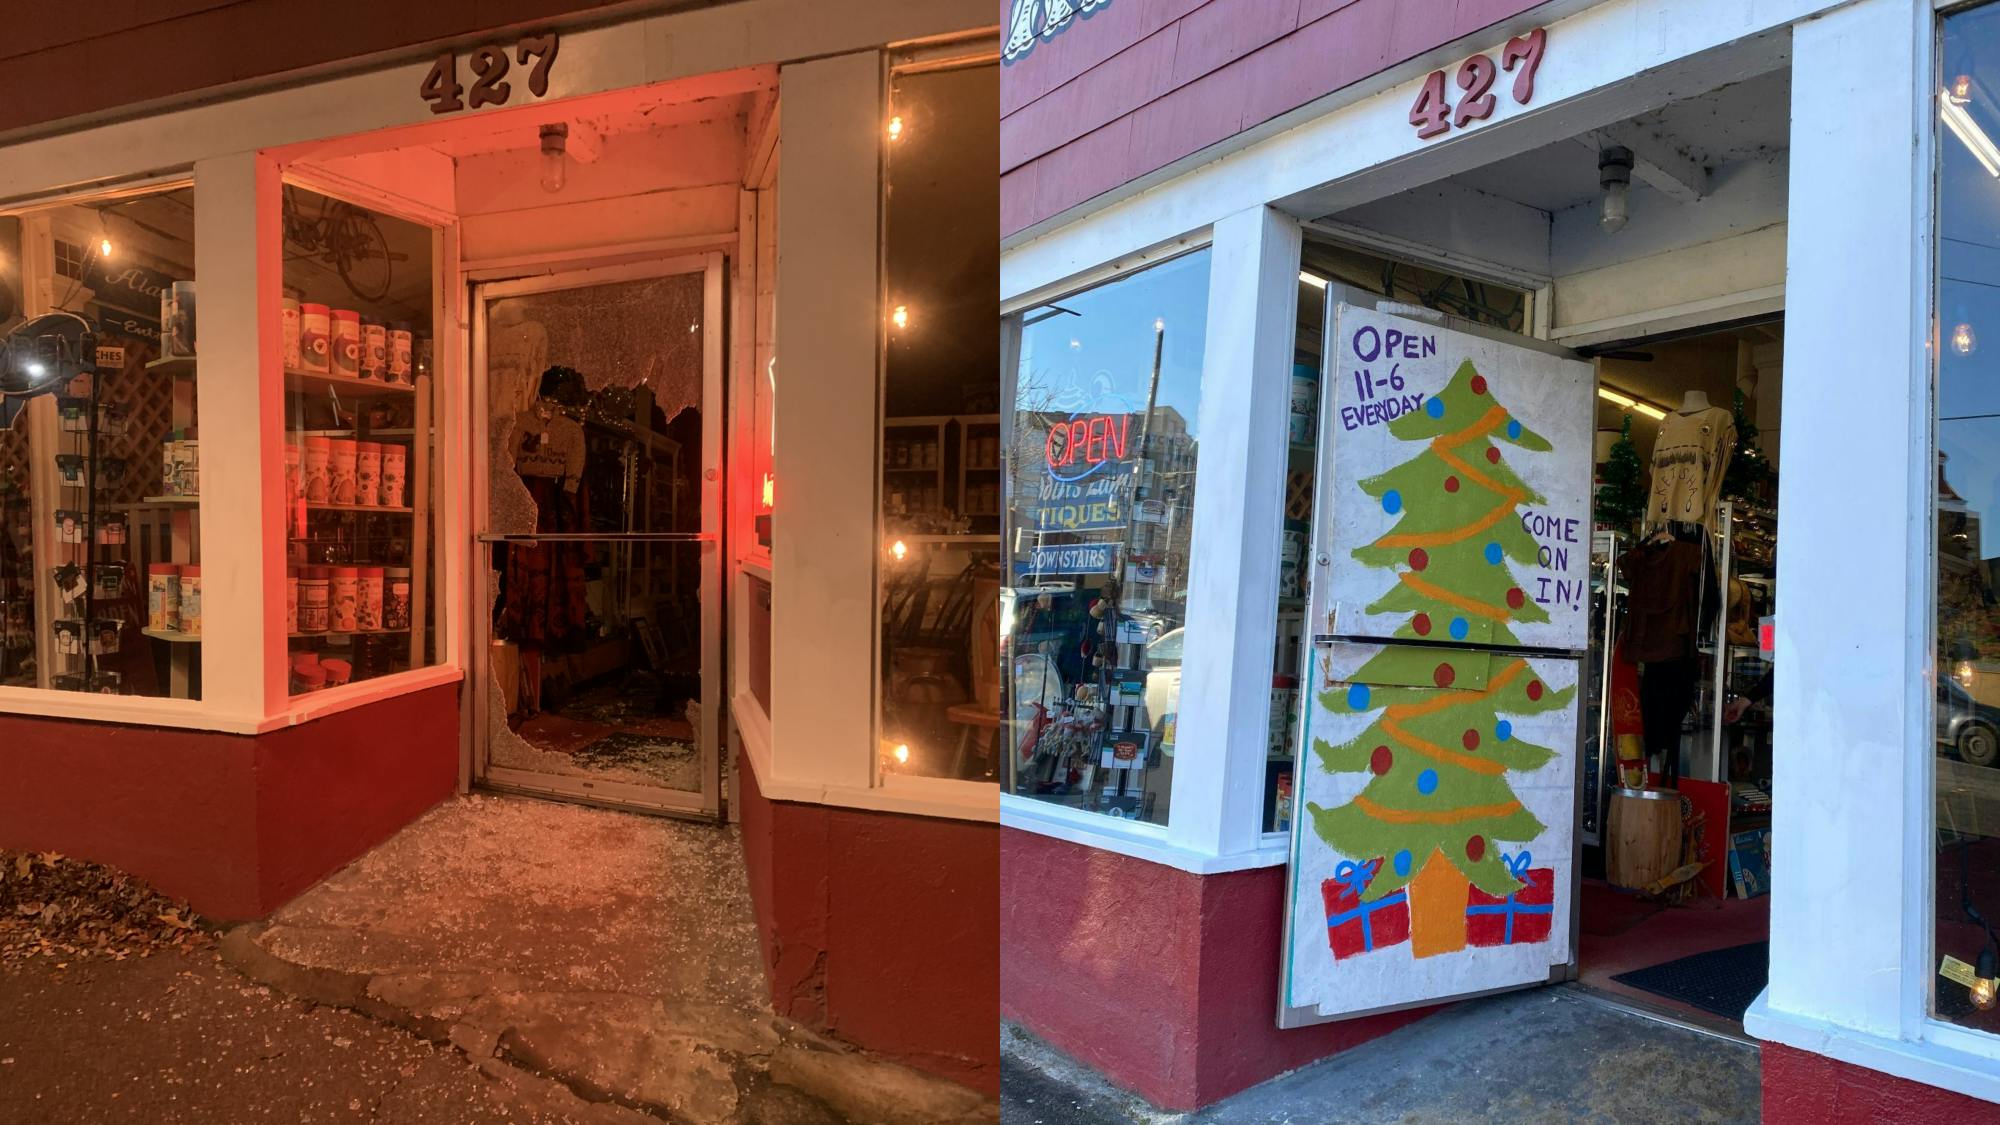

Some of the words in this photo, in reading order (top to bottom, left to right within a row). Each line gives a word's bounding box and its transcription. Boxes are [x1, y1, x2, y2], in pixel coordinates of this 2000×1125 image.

[420, 32, 559, 114] 427
[1408, 28, 1547, 140] 427
[1353, 325, 1436, 362] OPEN
[1354, 363, 1405, 402] 11-6
[1341, 392, 1424, 431] EVERYDAY
[1046, 413, 1130, 468] OPEN
[1521, 511, 1580, 543] COME
[1029, 548, 1106, 569] DOWNSTAIRS
[1537, 545, 1568, 572] ON
[1535, 577, 1583, 611] IN!
